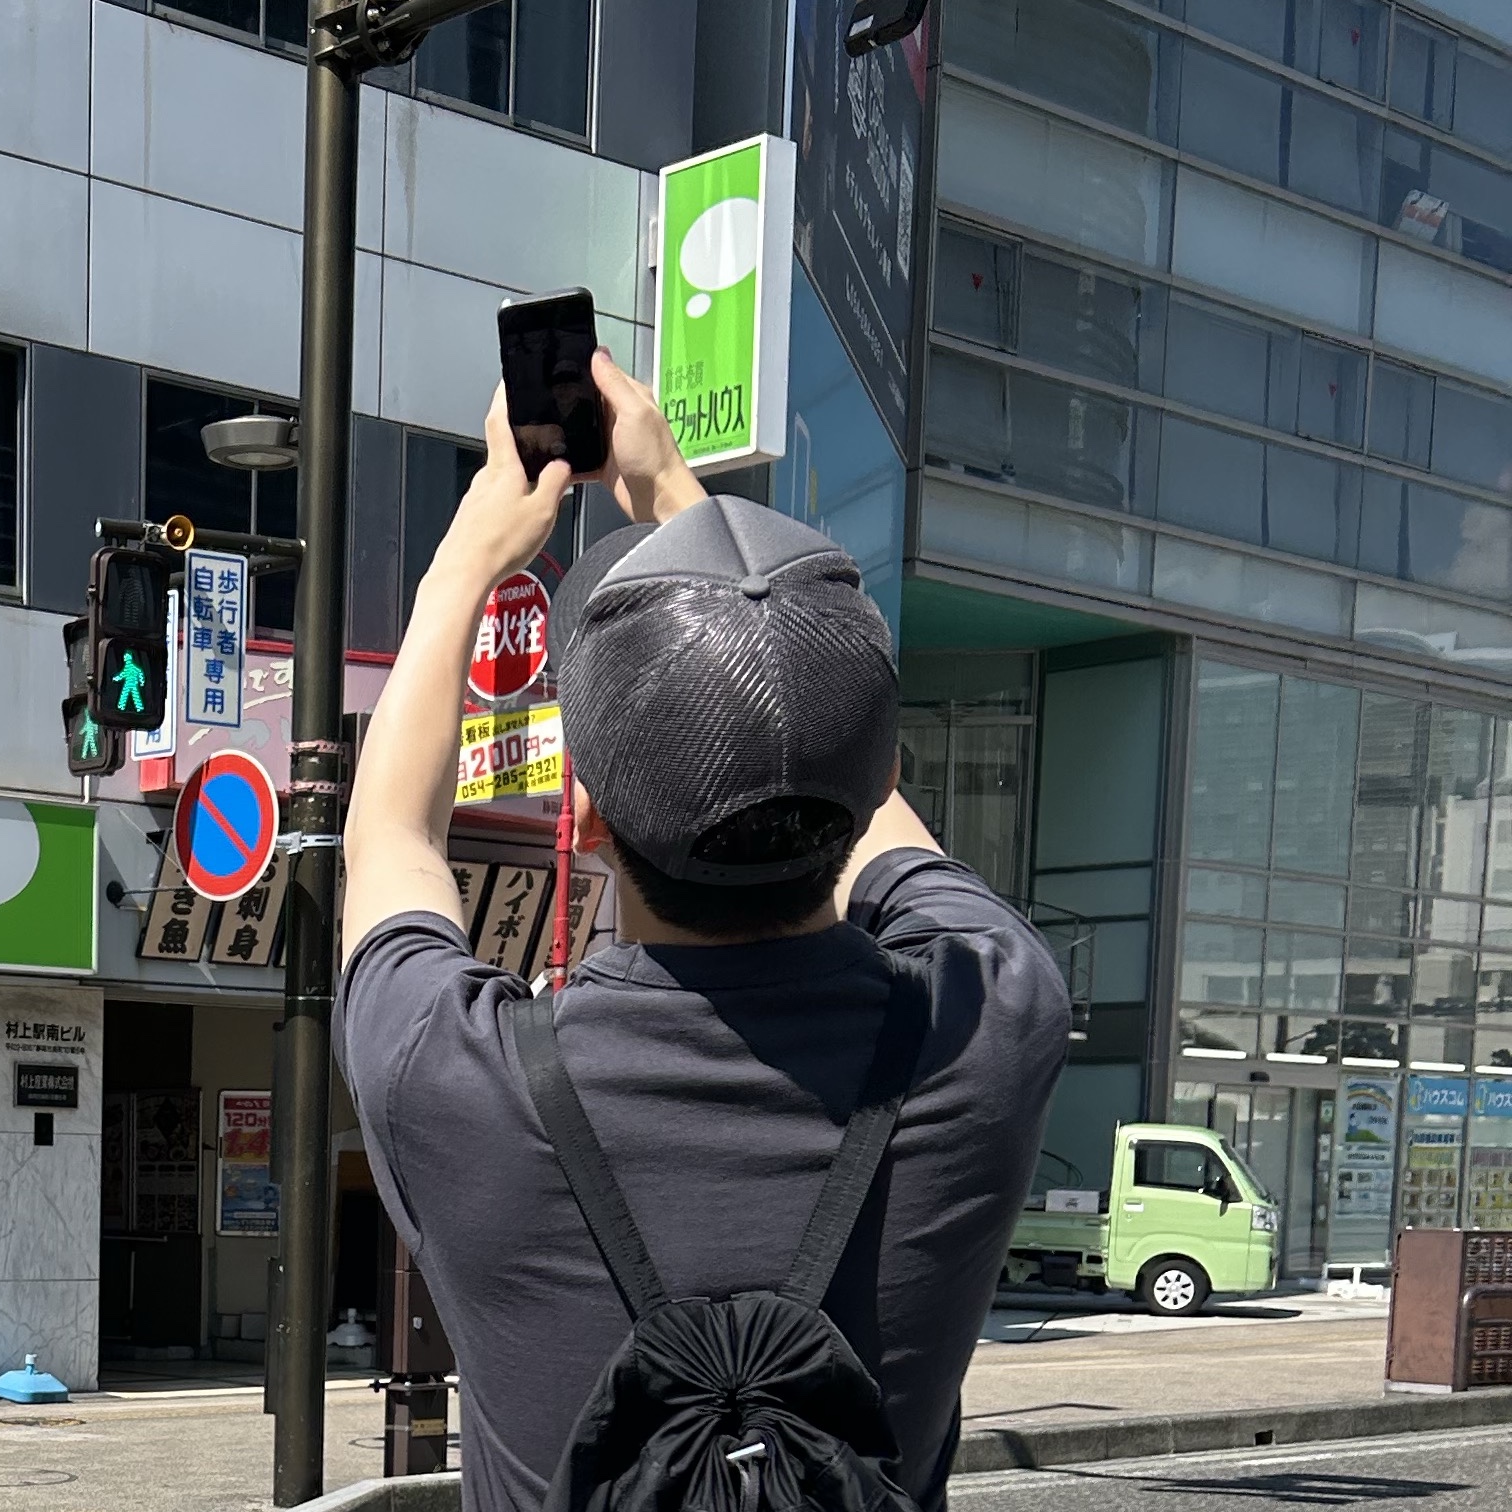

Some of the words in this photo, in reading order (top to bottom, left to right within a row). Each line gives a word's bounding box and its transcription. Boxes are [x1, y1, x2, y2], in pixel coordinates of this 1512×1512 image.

[191, 566, 215, 652] 自転車
[217, 569, 239, 656] 歩行者
[497, 583, 537, 602] HYDRANT
[202, 658, 226, 715] 専用
[461, 756, 557, 800] 054-285-2921
[158, 868, 197, 955] き魚
[5, 1021, 86, 1042] 村上駅南ビル
[1423, 1089, 1465, 1107] ハウスコム
